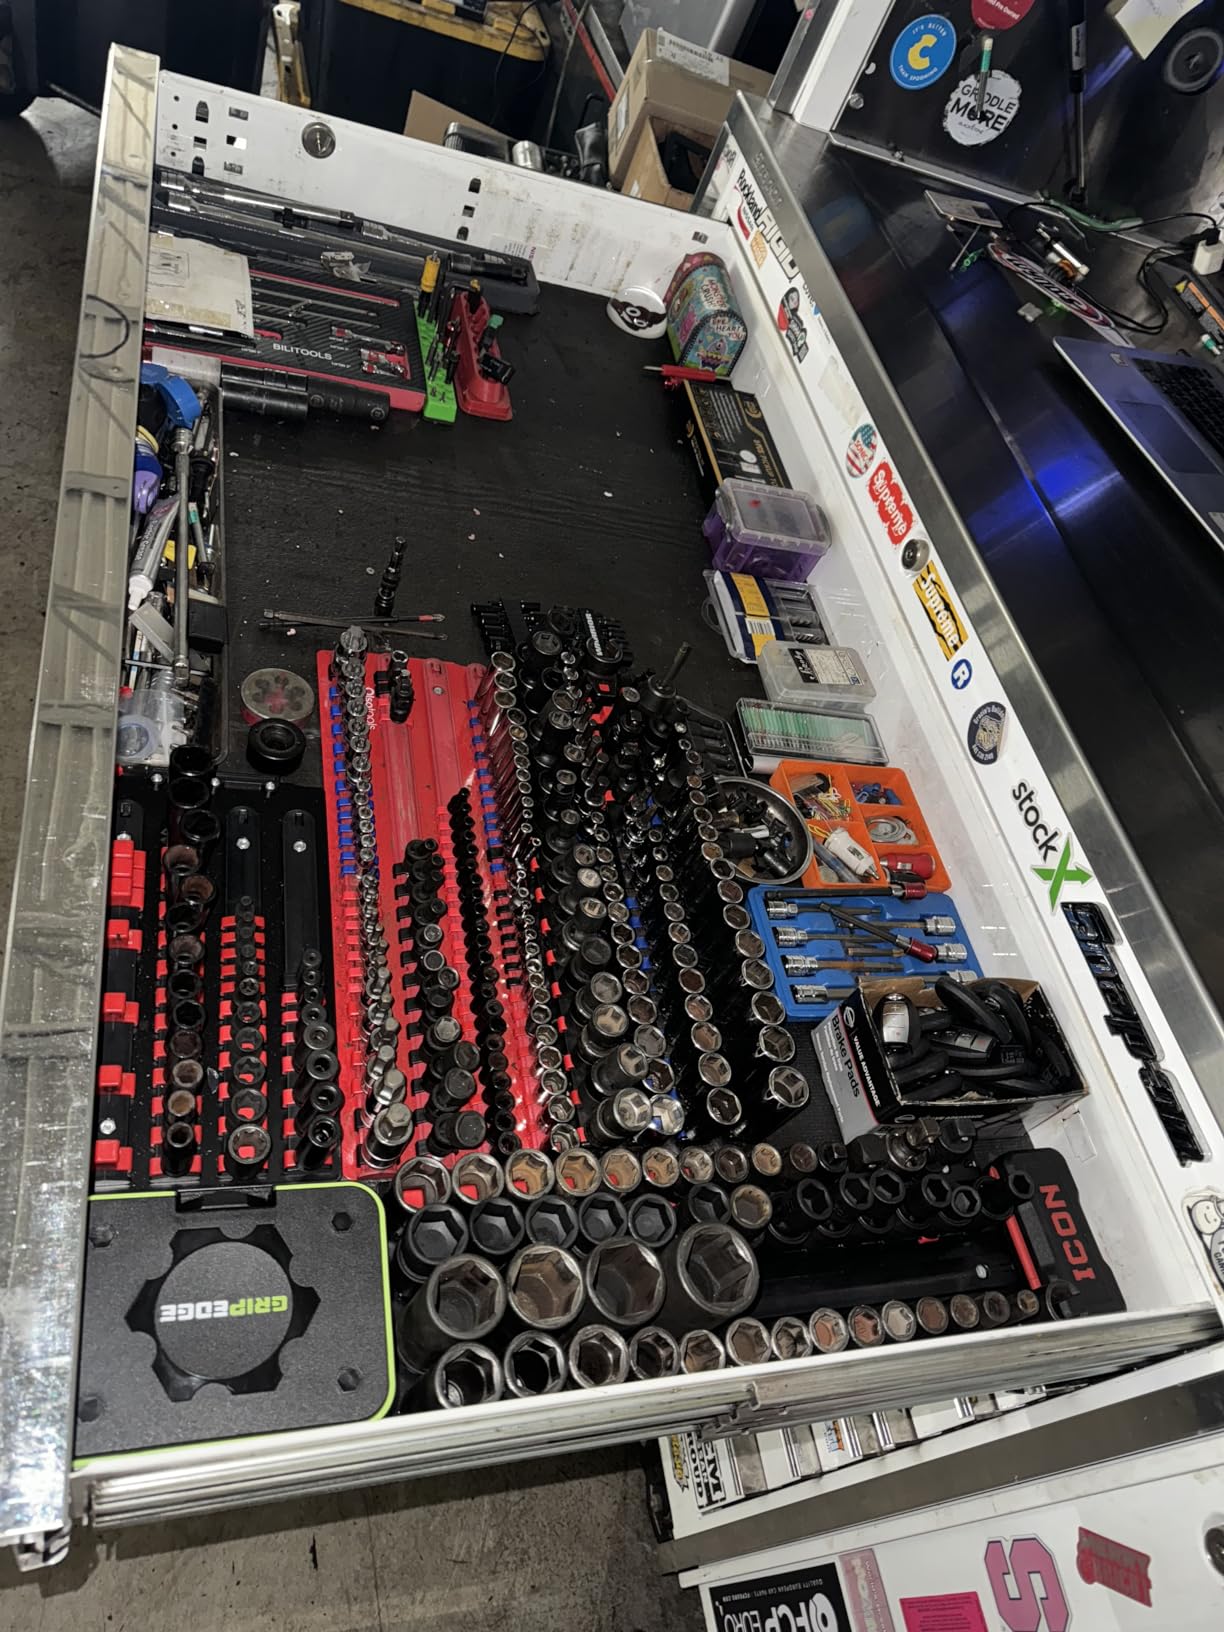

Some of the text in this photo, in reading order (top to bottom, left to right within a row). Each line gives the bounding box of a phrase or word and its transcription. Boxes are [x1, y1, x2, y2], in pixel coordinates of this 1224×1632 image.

[928, 22, 947, 37] BETTER
[898, 64, 909, 78] THAN
[961, 84, 1016, 114] GRDDLE
[950, 97, 1008, 132] MORE
[716, 323, 742, 333] HEART
[272, 342, 334, 361] BILITOOLS
[872, 468, 908, 537] Supreme
[919, 573, 961, 650] Supreme
[953, 661, 971, 687] R
[831, 1015, 853, 1057] Brake
[843, 1060, 861, 1098] Pads
[853, 1035, 882, 1107] VALUE ADVANTAGE
[1039, 1184, 1096, 1281] ICON
[767, 1587, 777, 1595] CAR
[777, 1583, 802, 1595] EUROPEAN
[801, 1578, 824, 1591] QUALITY
